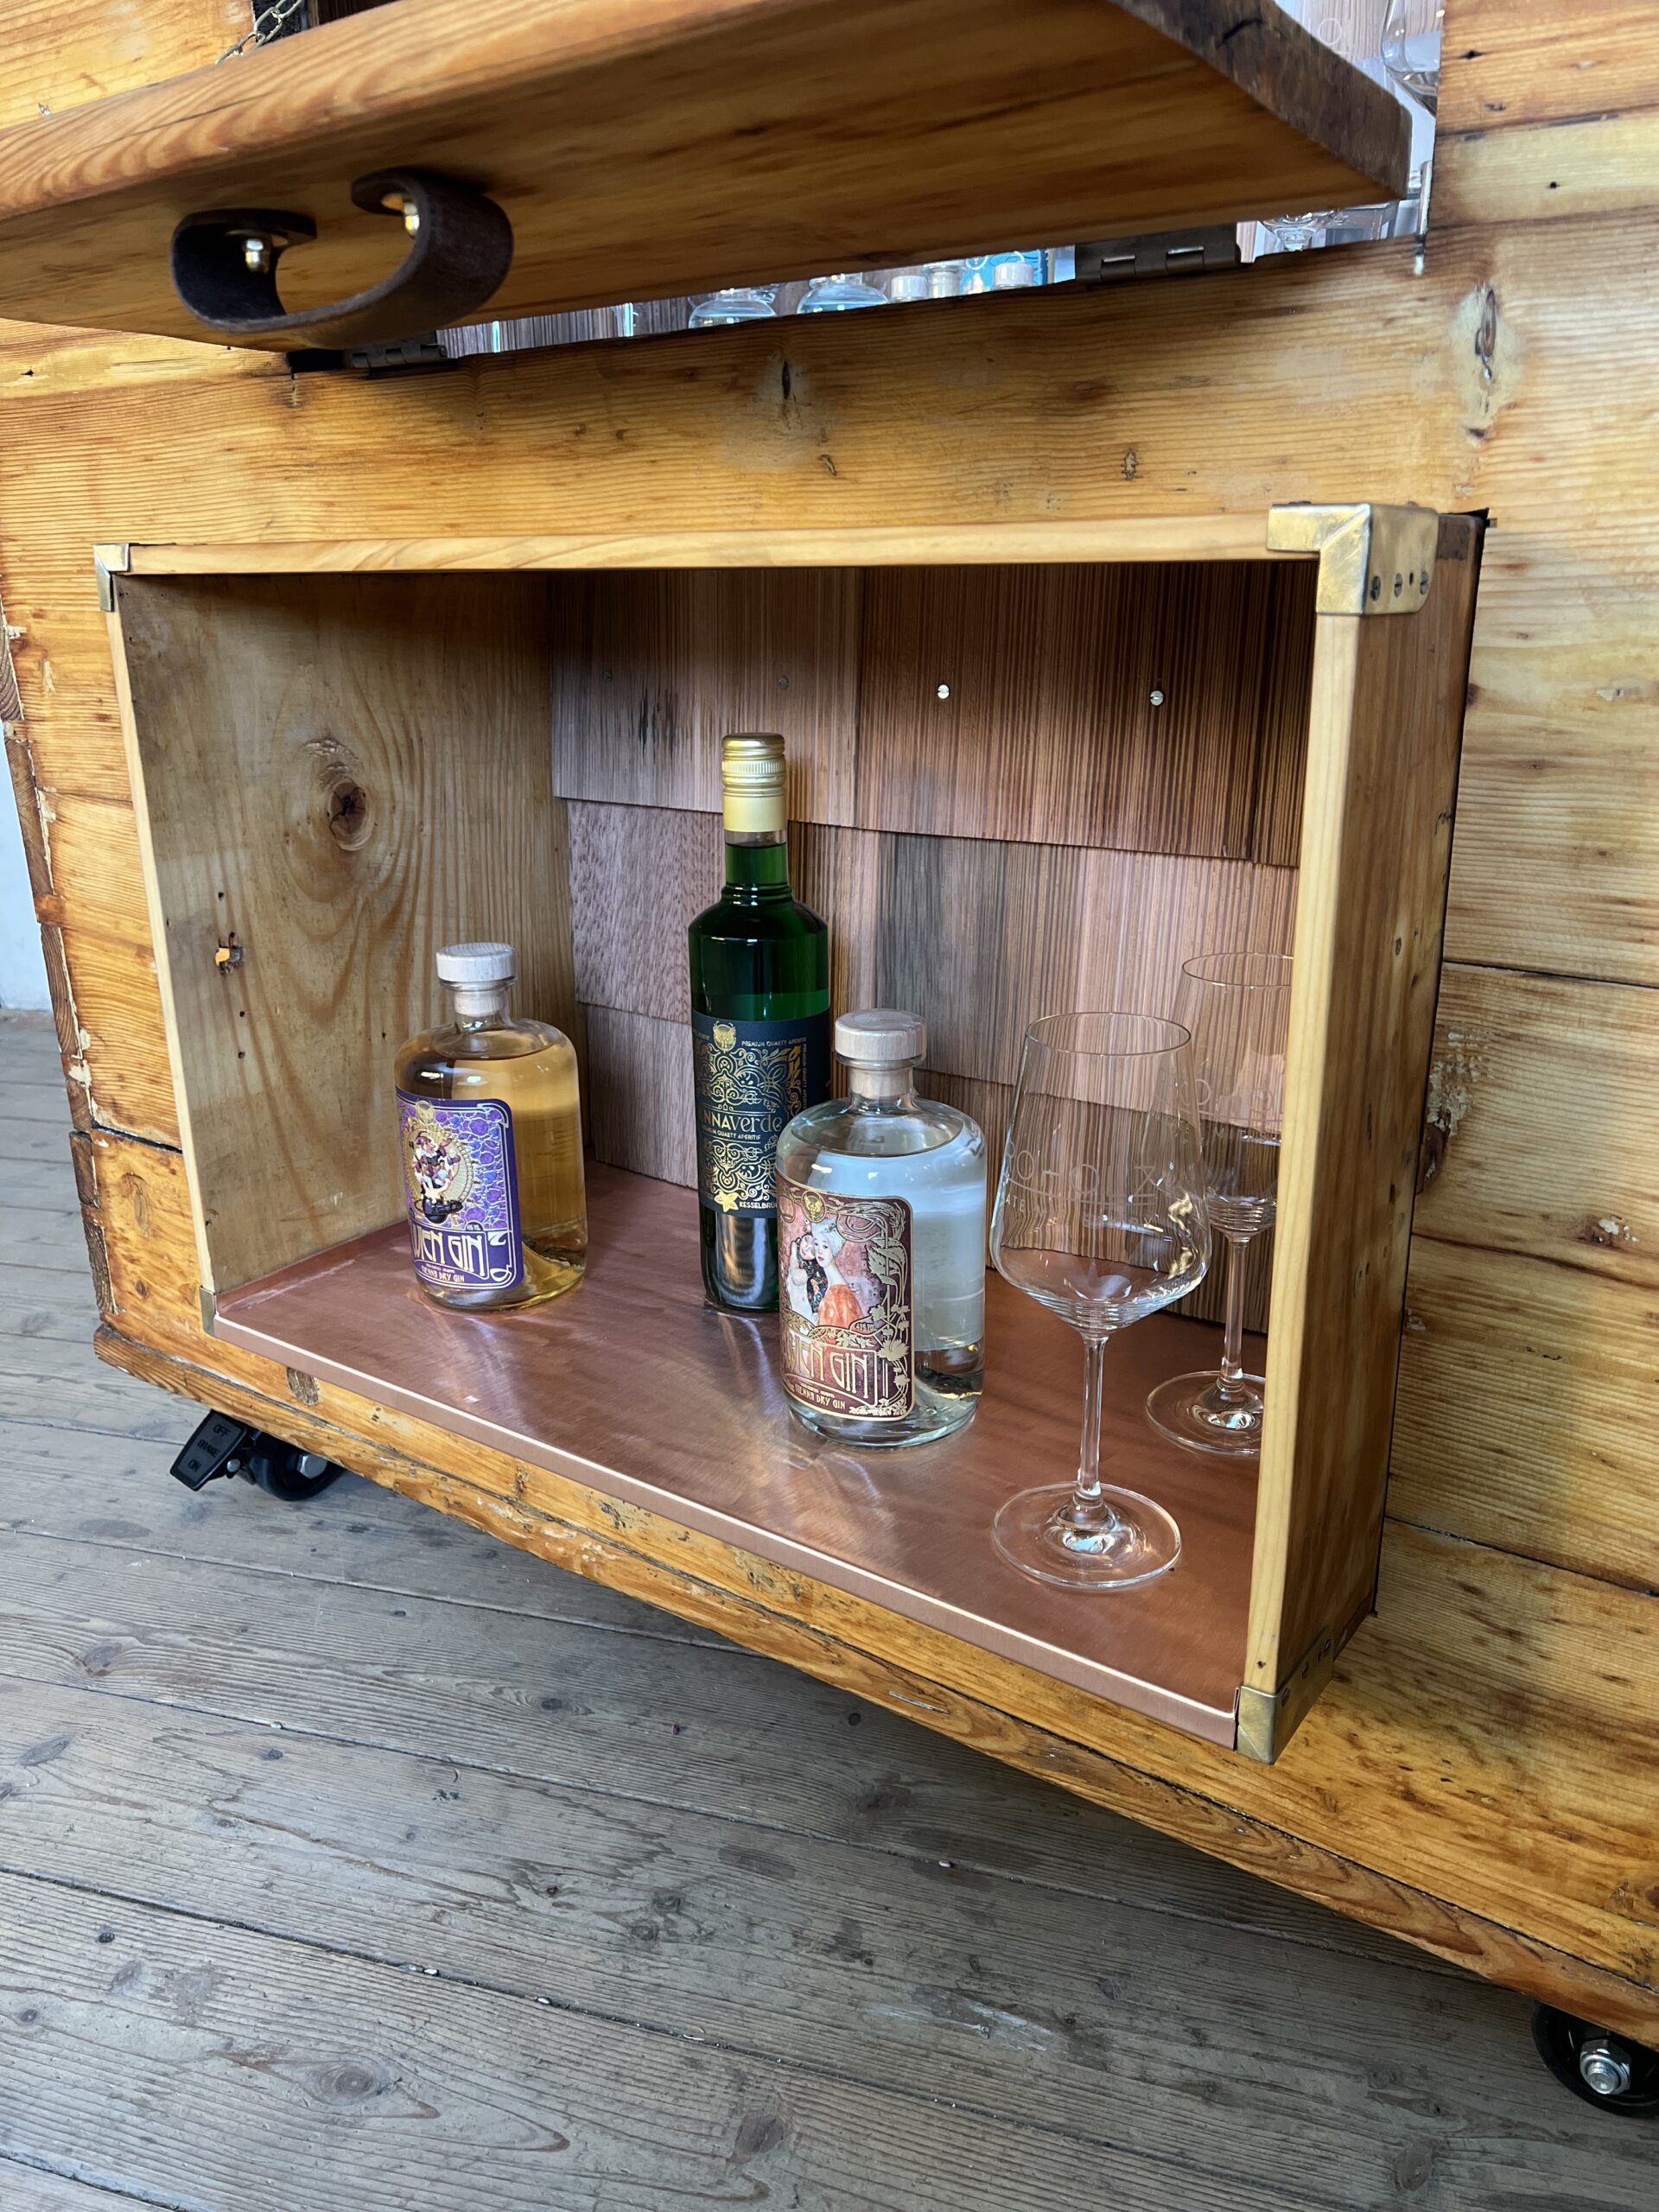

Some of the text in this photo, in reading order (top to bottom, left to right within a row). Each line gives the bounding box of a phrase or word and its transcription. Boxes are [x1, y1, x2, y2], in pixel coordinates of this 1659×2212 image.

[701, 1108, 782, 1133] NNAVerde
[739, 1199, 778, 1209] KESSELBRÜ
[411, 1223, 486, 1277] WIEN GIN
[439, 1272, 452, 1281] DRY
[453, 1274, 465, 1283] GIN
[830, 1351, 869, 1399] GIN
[816, 1394, 830, 1406] DRY
[832, 1399, 846, 1410] GIN
[213, 1423, 232, 1437] OFF
[197, 1439, 220, 1458] BRAKE
[188, 1459, 202, 1471] ON
